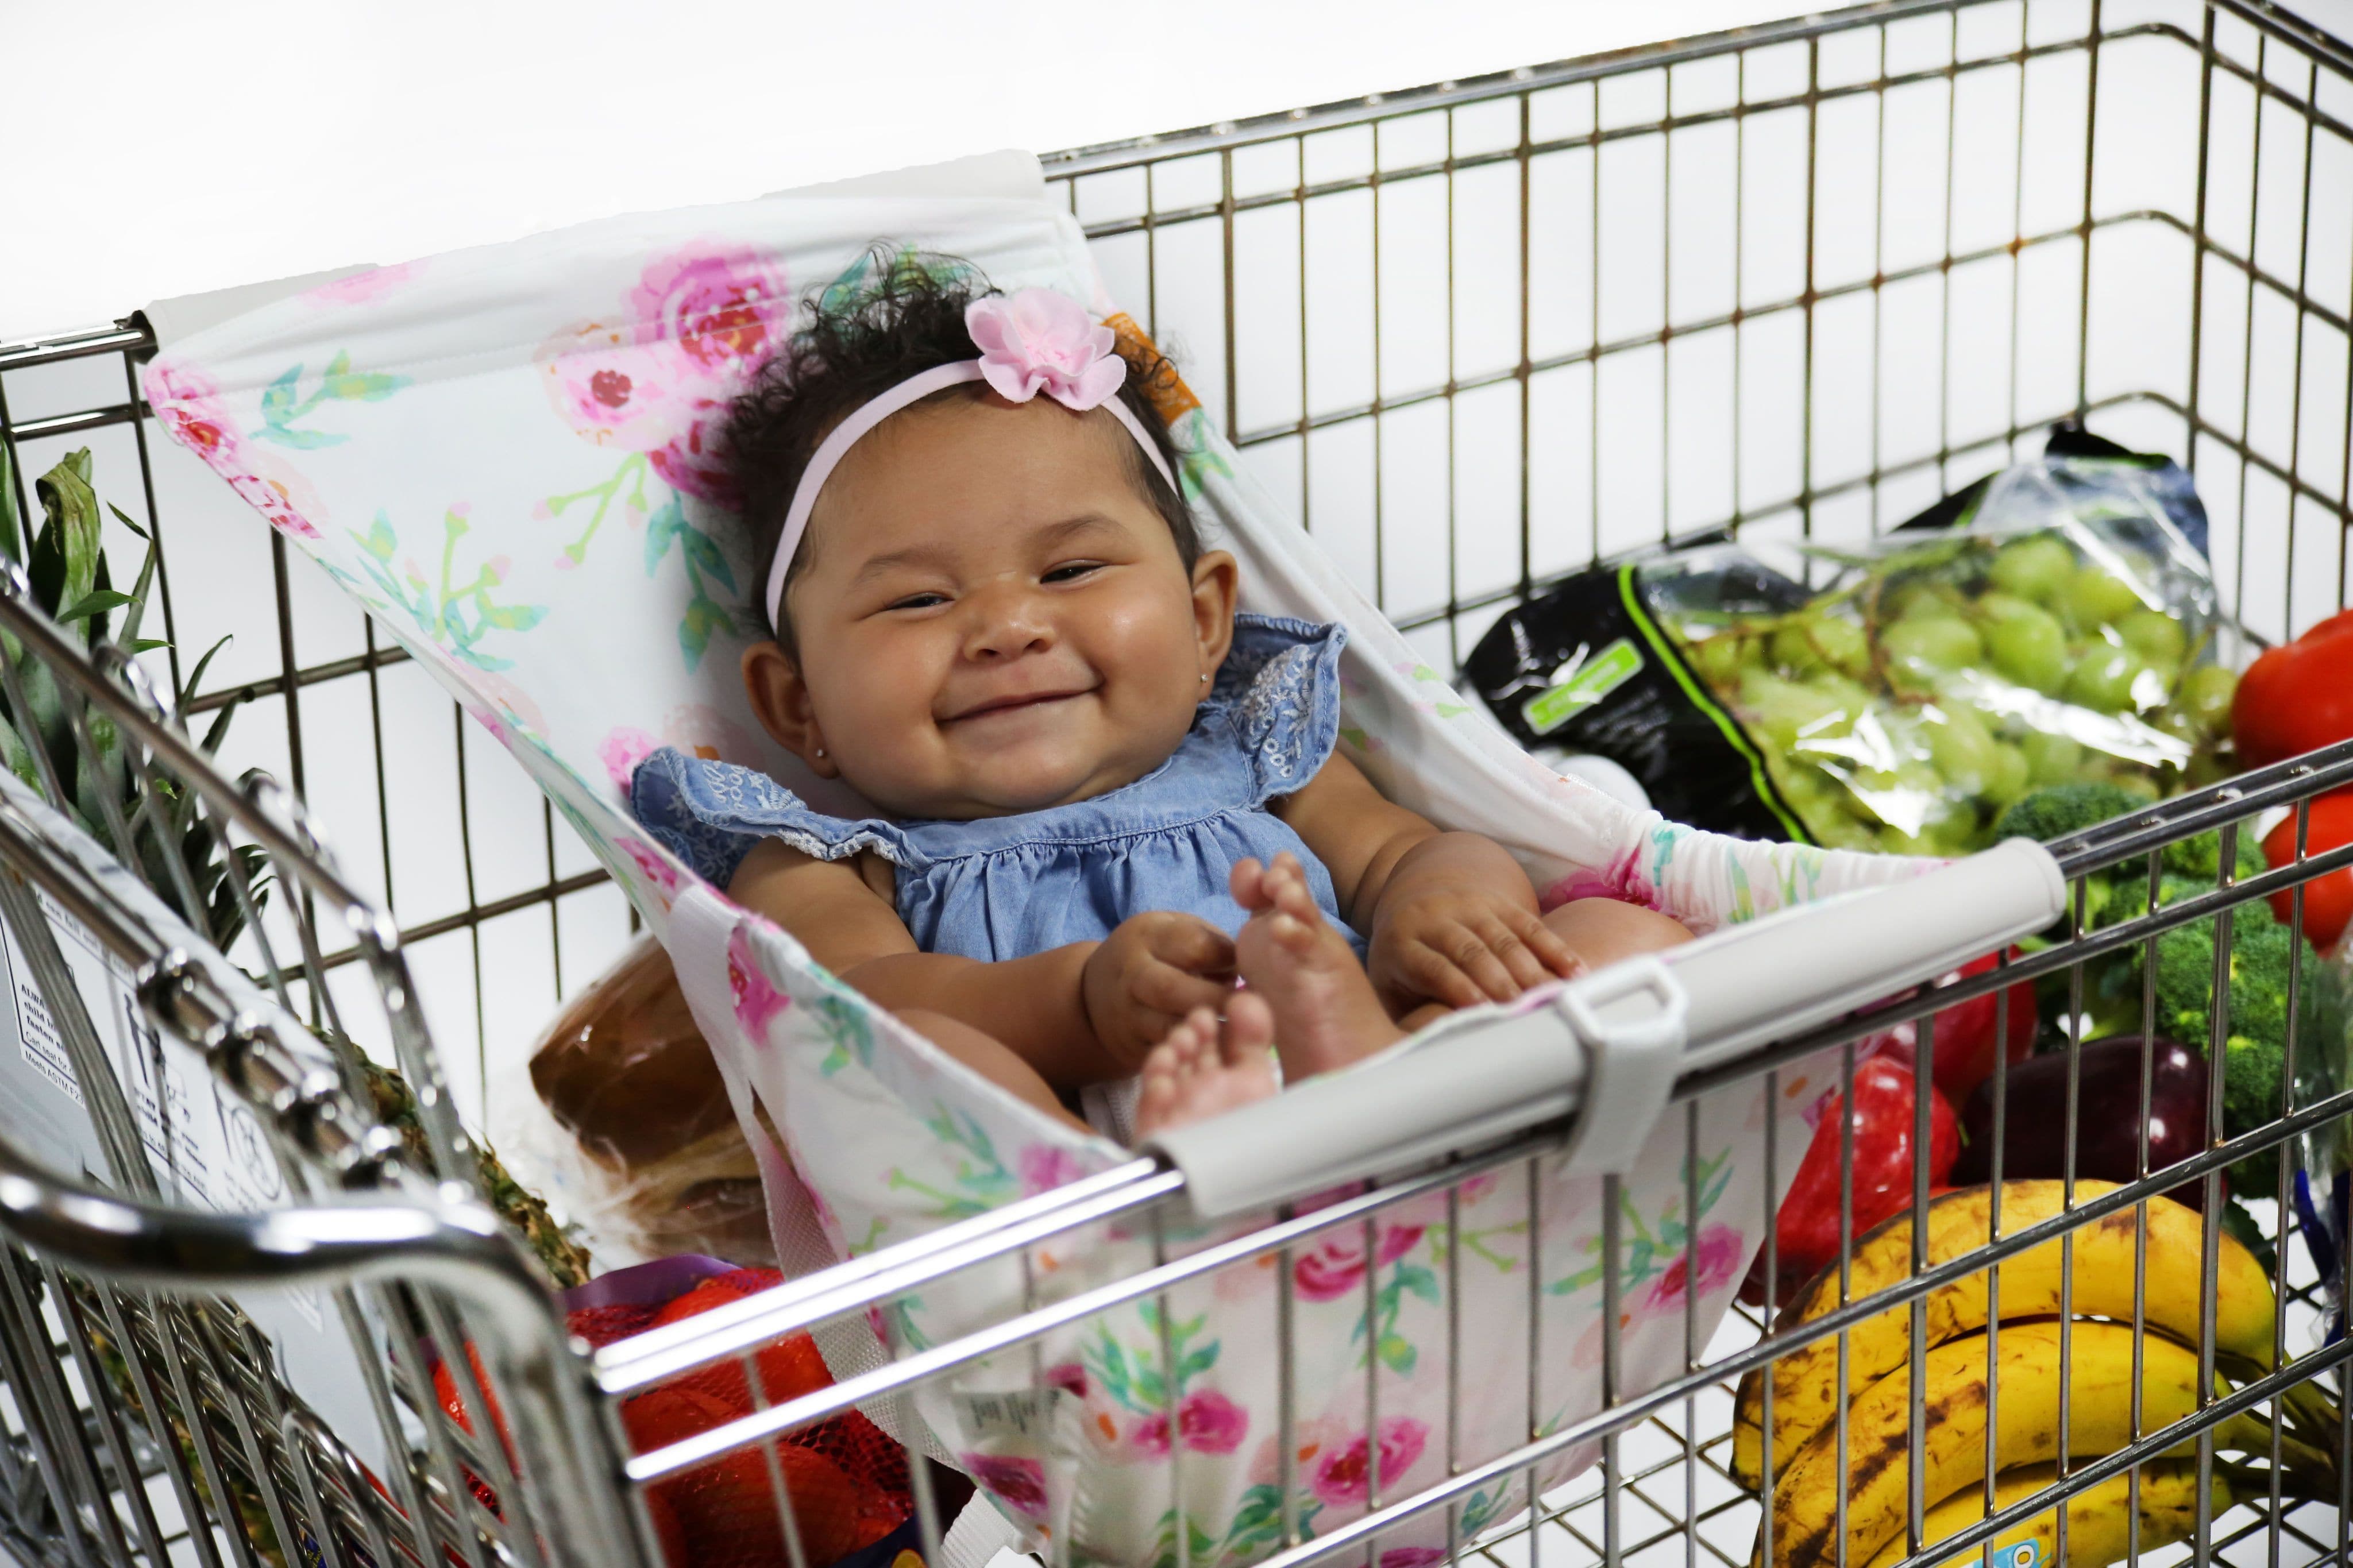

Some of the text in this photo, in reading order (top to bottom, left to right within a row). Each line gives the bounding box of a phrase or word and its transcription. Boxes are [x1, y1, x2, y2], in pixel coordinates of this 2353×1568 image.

[22, 984, 45, 1010] ALWA
[24, 1002, 44, 1022] child
[27, 1015, 53, 1043] fasten
[26, 1031, 40, 1051] Cart
[43, 1046, 56, 1064] seat
[26, 1050, 84, 1104] Meets ASTM F23
